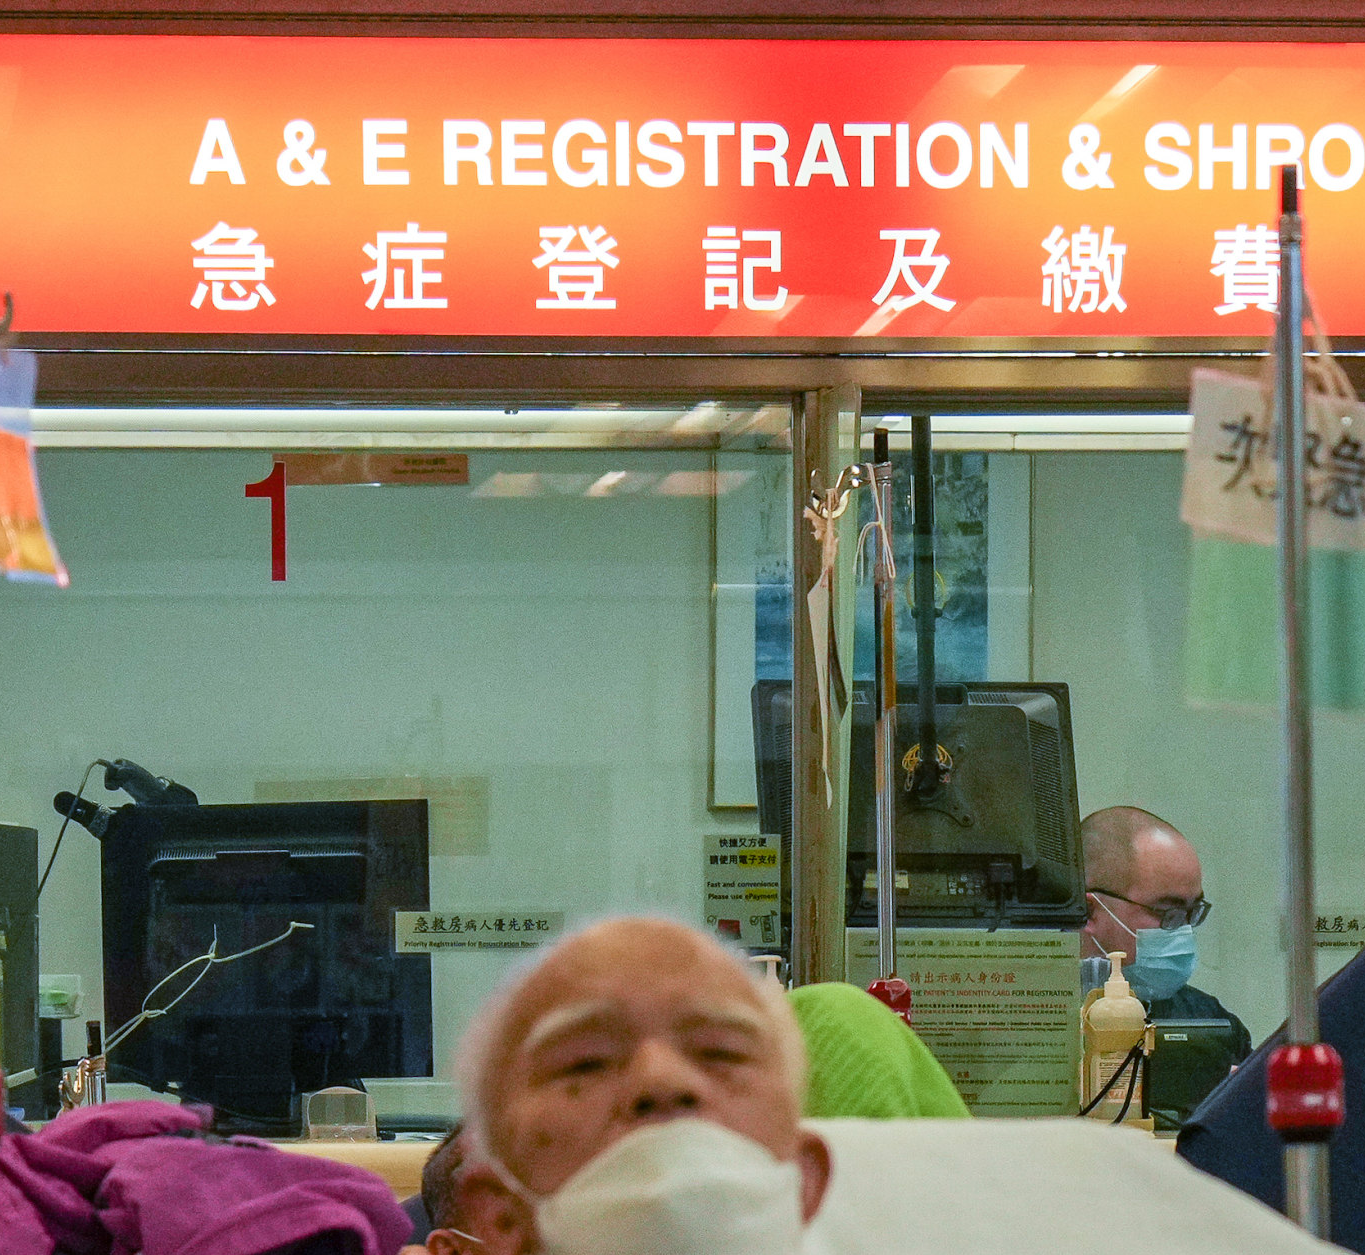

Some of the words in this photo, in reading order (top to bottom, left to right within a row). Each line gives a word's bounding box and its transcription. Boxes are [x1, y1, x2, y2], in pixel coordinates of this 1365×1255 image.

[189, 117, 245, 185] A
[276, 118, 329, 186] &
[362, 118, 409, 185] E
[442, 118, 1029, 188] REGISTRATION
[1061, 122, 1114, 190] &
[245, 461, 286, 581] 1
[719, 837, 767, 848] 快捷又方便
[709, 854, 777, 866] 請使用電子支付
[413, 916, 550, 933] 急救房病人優先登記
[908, 971, 1017, 985] 請出示病人身份證
